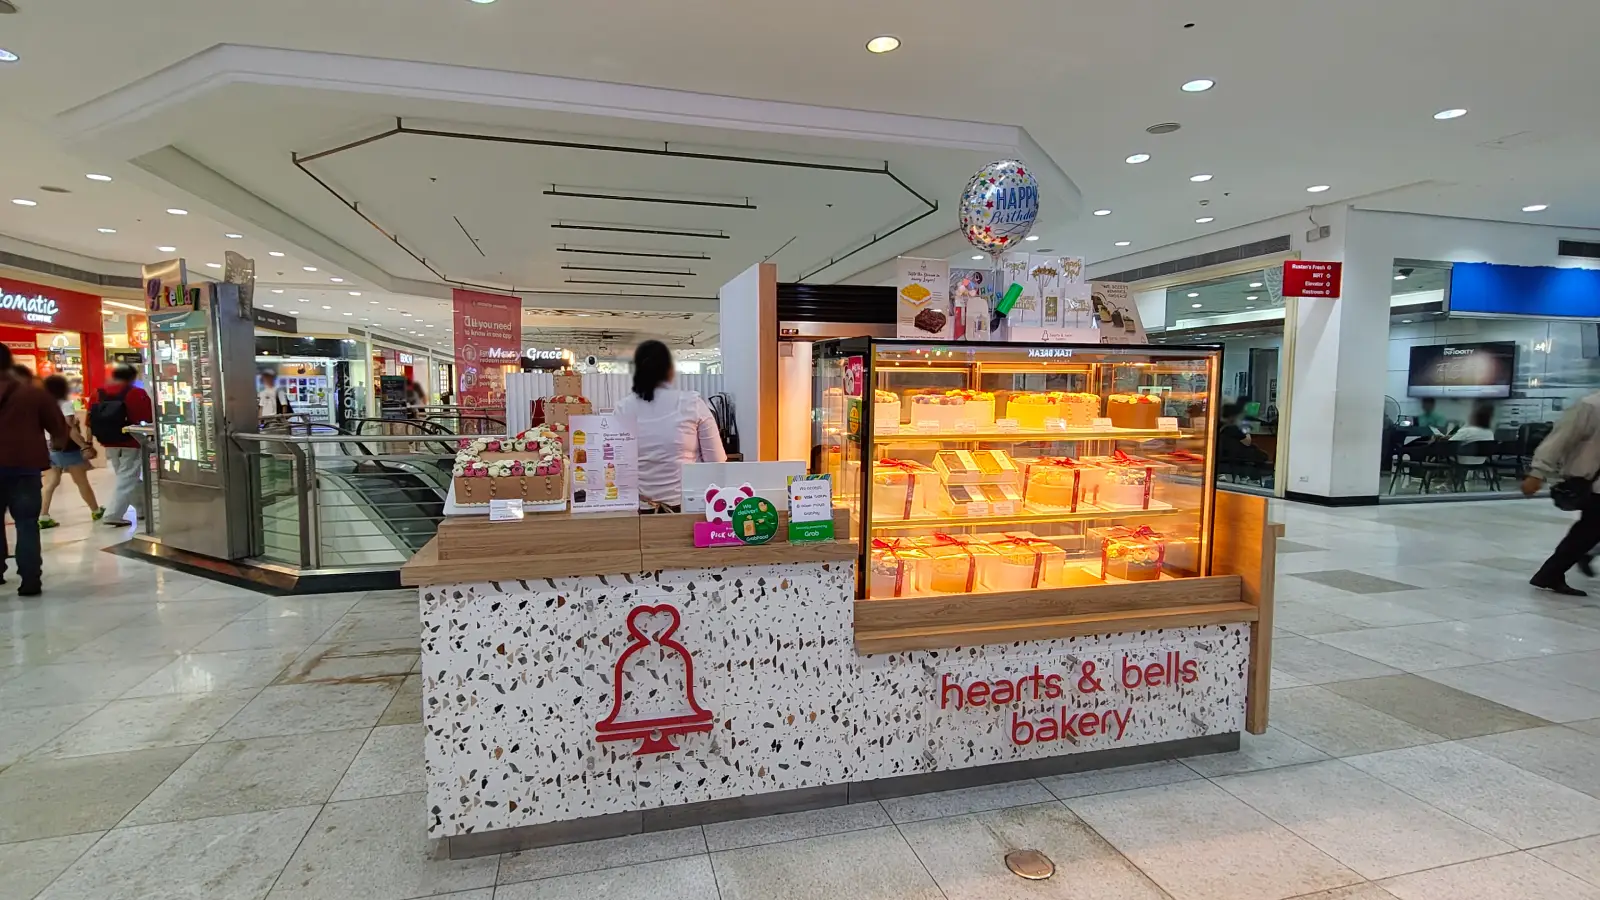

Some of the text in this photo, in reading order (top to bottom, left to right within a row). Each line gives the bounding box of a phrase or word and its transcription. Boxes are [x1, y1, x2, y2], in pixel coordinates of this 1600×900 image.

[996, 185, 1038, 210] HAPPY
[987, 209, 1036, 226] Birthda
[526, 347, 563, 361] Grace
[344, 374, 352, 419] SONY
[710, 530, 726, 539] PICK
[940, 650, 1200, 711] hearts & bells
[1010, 704, 1133, 746] bakery
